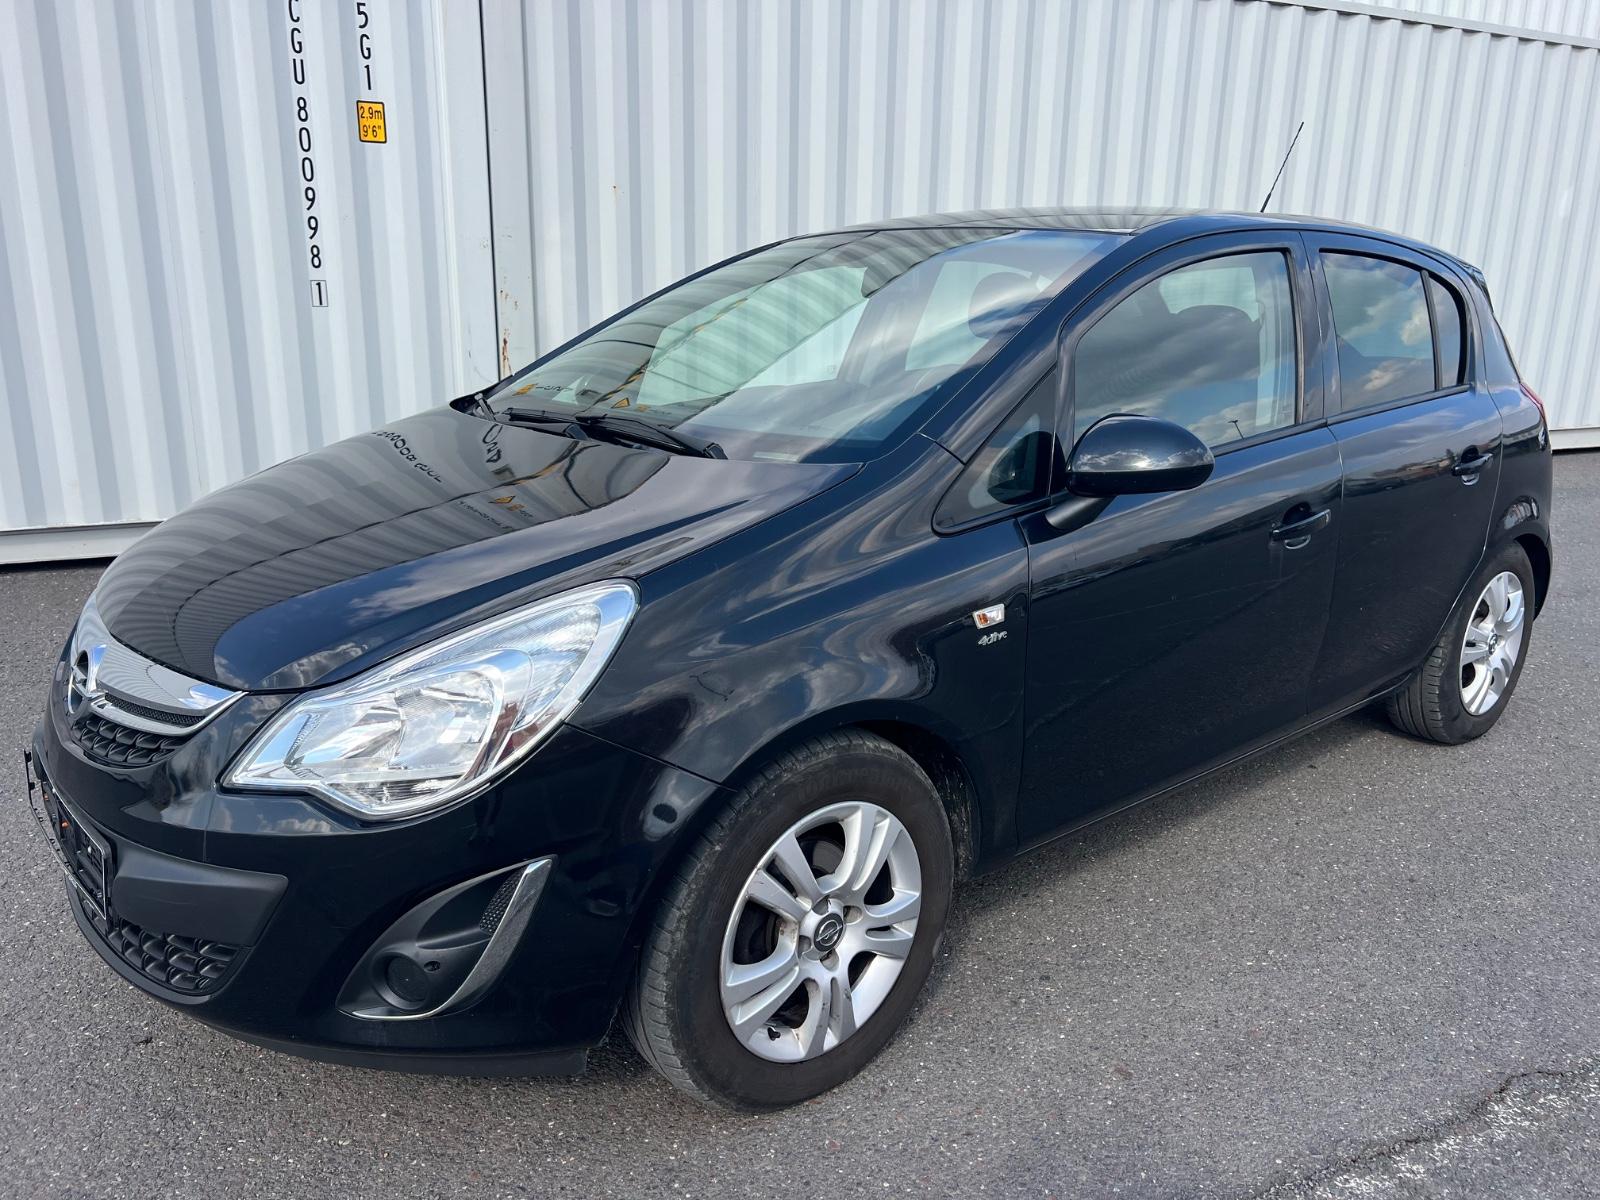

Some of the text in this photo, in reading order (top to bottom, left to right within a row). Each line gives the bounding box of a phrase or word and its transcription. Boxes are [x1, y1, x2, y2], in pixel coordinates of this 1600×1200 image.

[288, 0, 305, 85] CGU
[297, 96, 322, 269] 800998
[356, 2, 372, 91] 5G1
